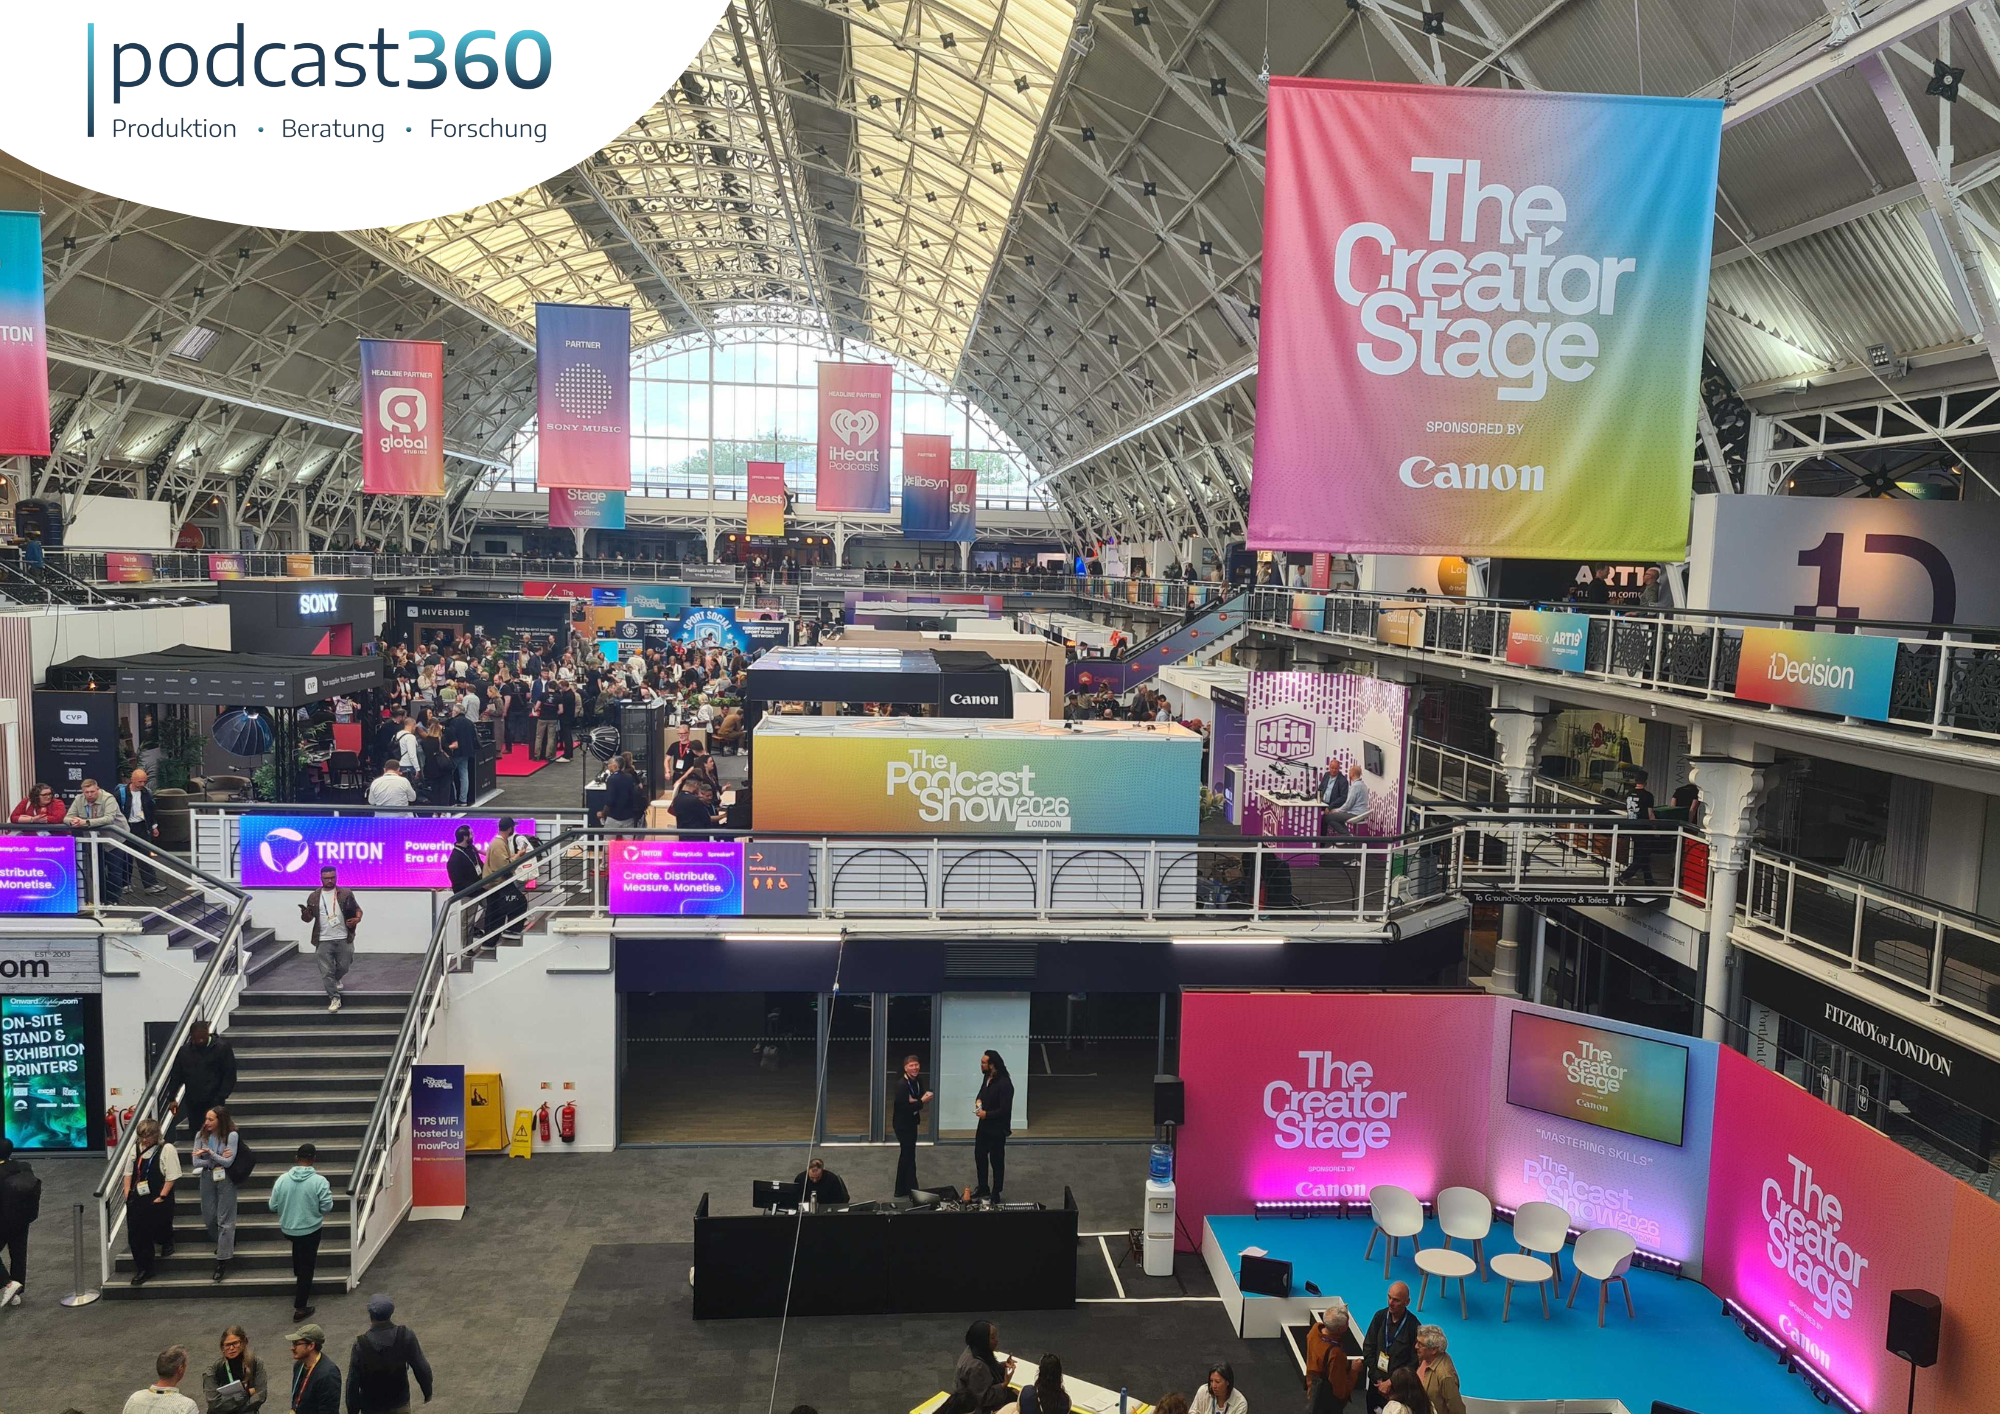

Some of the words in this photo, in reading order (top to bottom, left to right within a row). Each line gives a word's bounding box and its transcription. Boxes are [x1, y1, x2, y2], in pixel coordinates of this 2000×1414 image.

[1410, 156, 1567, 246] The
[1333, 221, 1636, 316] Creator
[565, 340, 601, 349] PARTNER
[1356, 291, 1599, 401] Stage
[371, 369, 403, 378] HEADLINE
[403, 370, 433, 379] PARTNER
[546, 423, 579, 431] SONY
[582, 425, 621, 433] MUSIC
[1426, 421, 1503, 435] SPONSORED
[1506, 423, 1524, 435] BY
[380, 434, 428, 453] global
[829, 445, 879, 462] iHeart
[829, 460, 879, 472] Podcasts
[1399, 455, 1544, 491] Canon
[914, 475, 949, 490] libsyn
[567, 488, 606, 504] Stage
[749, 493, 783, 504] Acast
[574, 509, 601, 517] podimo
[300, 593, 338, 614] SONY
[421, 609, 470, 617] RIVERSIDE
[683, 611, 705, 630] SPORT
[706, 611, 732, 631] SOCIAL
[1528, 632, 1543, 643] music
[1553, 631, 1581, 647] ART19
[950, 693, 999, 705] Canon
[908, 749, 948, 769] The
[886, 761, 1035, 796] Podcast
[1676, 755, 1686, 784] NEW
[918, 786, 1019, 822] Show
[1016, 797, 1069, 817] 2026
[1026, 820, 1062, 828] LONDON
[315, 841, 383, 860] TRITON
[405, 841, 454, 852] Powerin
[405, 854, 424, 863] Era
[426, 853, 438, 863] of
[0, 880, 55, 889] Monetise.
[623, 871, 662, 881] Create.
[664, 871, 717, 881] Distribute.
[623, 883, 672, 892] Measure.
[673, 883, 724, 892] Monetise.
[1534, 895, 1576, 903] Showrooms
[1586, 896, 1609, 904] Toilets
[0, 959, 50, 978] om
[2, 1013, 63, 1030] ON-SITE
[2, 1031, 51, 1046] STAND
[55, 1029, 66, 1041] &
[1824, 1002, 1879, 1042] FITZROY
[1876, 1033, 1889, 1047] OF
[1888, 1032, 1953, 1077] LONDON
[4, 1043, 85, 1061] EXHIBITION
[1578, 1040, 1612, 1064] The
[7, 1060, 78, 1077] PRINTERS
[1298, 1051, 1373, 1088] The
[1562, 1050, 1628, 1080] Creator
[1567, 1065, 1620, 1094] Stage
[1263, 1080, 1407, 1119] Creator
[1576, 1098, 1609, 1112] Canon
[417, 1116, 437, 1126] TPS
[438, 1116, 459, 1125] WiFi
[413, 1129, 448, 1138] hosted
[450, 1129, 463, 1139] by
[1275, 1110, 1391, 1159] Stage
[417, 1141, 460, 1150] mowPod
[1539, 1154, 1568, 1175] The
[1295, 1181, 1366, 1197] Canon
[1523, 1159, 1633, 1214] Podcast
[1787, 1153, 1843, 1231] The
[1545, 1184, 1618, 1228] Show
[1617, 1212, 1660, 1236] 2026
[1761, 1177, 1869, 1288] Creator
[1767, 1218, 1853, 1320] Stage
[1778, 1314, 1831, 1370] Canon
